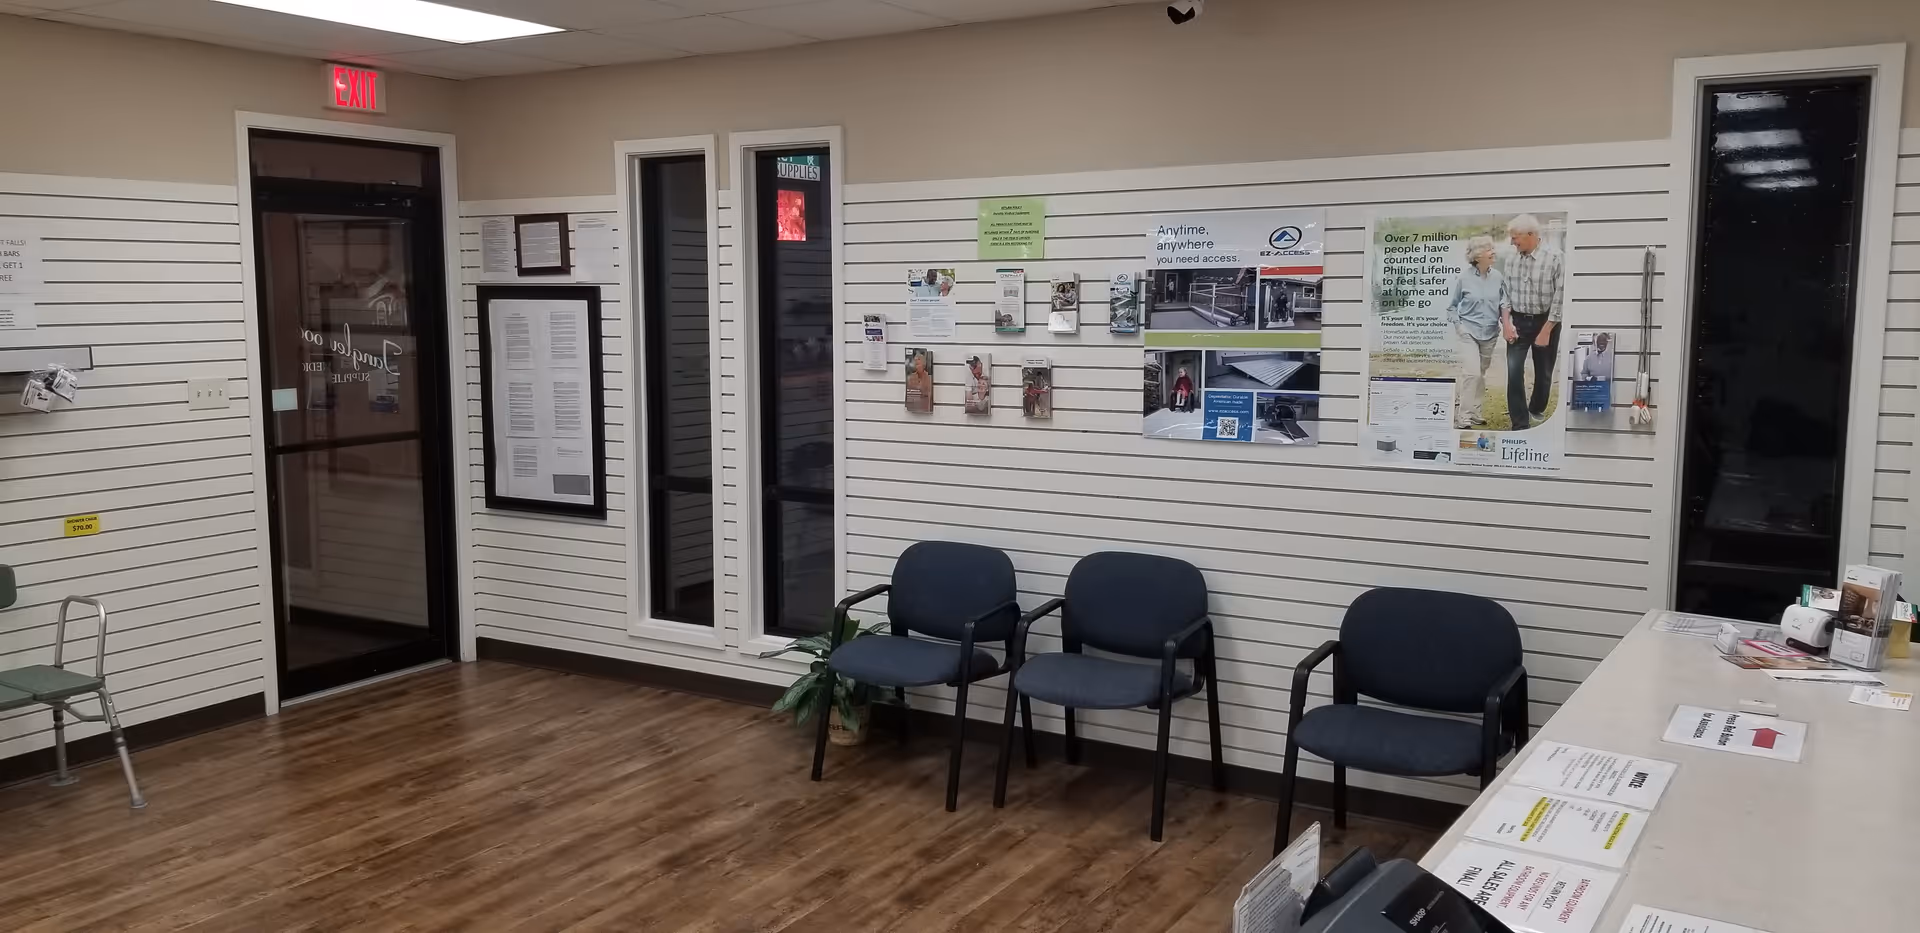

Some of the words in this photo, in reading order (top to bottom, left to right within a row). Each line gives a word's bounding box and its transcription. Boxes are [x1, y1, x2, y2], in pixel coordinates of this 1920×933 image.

[334, 66, 378, 110] EXIT
[1156, 224, 1209, 238] Anytime,
[1385, 234, 1409, 242] Over
[1422, 232, 1458, 242] million
[1156, 239, 1214, 253] anywhere
[1384, 245, 1420, 254] people
[1424, 244, 1449, 252] have
[1156, 256, 1173, 266] you
[1176, 254, 1200, 264] need
[1202, 254, 1240, 263] access.
[1384, 255, 1426, 264] counted
[1383, 266, 1418, 276] Philips
[1422, 266, 1460, 274] Lifeline
[1396, 277, 1416, 285] feel
[1420, 276, 1446, 285] safer
[1396, 288, 1425, 296] home
[1428, 287, 1448, 296] and
[1399, 298, 1415, 307] the
[1418, 300, 1431, 308] go
[1502, 446, 1549, 463] Lifeline
[73, 524, 92, 532] $70.00
[1726, 713, 1740, 725] Press
[1722, 725, 1736, 734] Red
[1717, 733, 1734, 746] Button
[1495, 859, 1517, 871] ALL
[1454, 865, 1483, 887] FINAL!
[1480, 870, 1508, 891] SALES
[1512, 864, 1535, 886] BATHROOM
[1526, 876, 1547, 893] REFUNDS
[1548, 880, 1567, 895] RETURN
[1569, 878, 1591, 899] BATHROOM
[1469, 890, 1494, 905] ARE
[1521, 892, 1536, 901] FOR
[1540, 894, 1558, 909] POLICY
[1514, 900, 1531, 911] ANY
[1554, 898, 1580, 923] EQUIPMENT
[1409, 907, 1426, 927] SHARP
